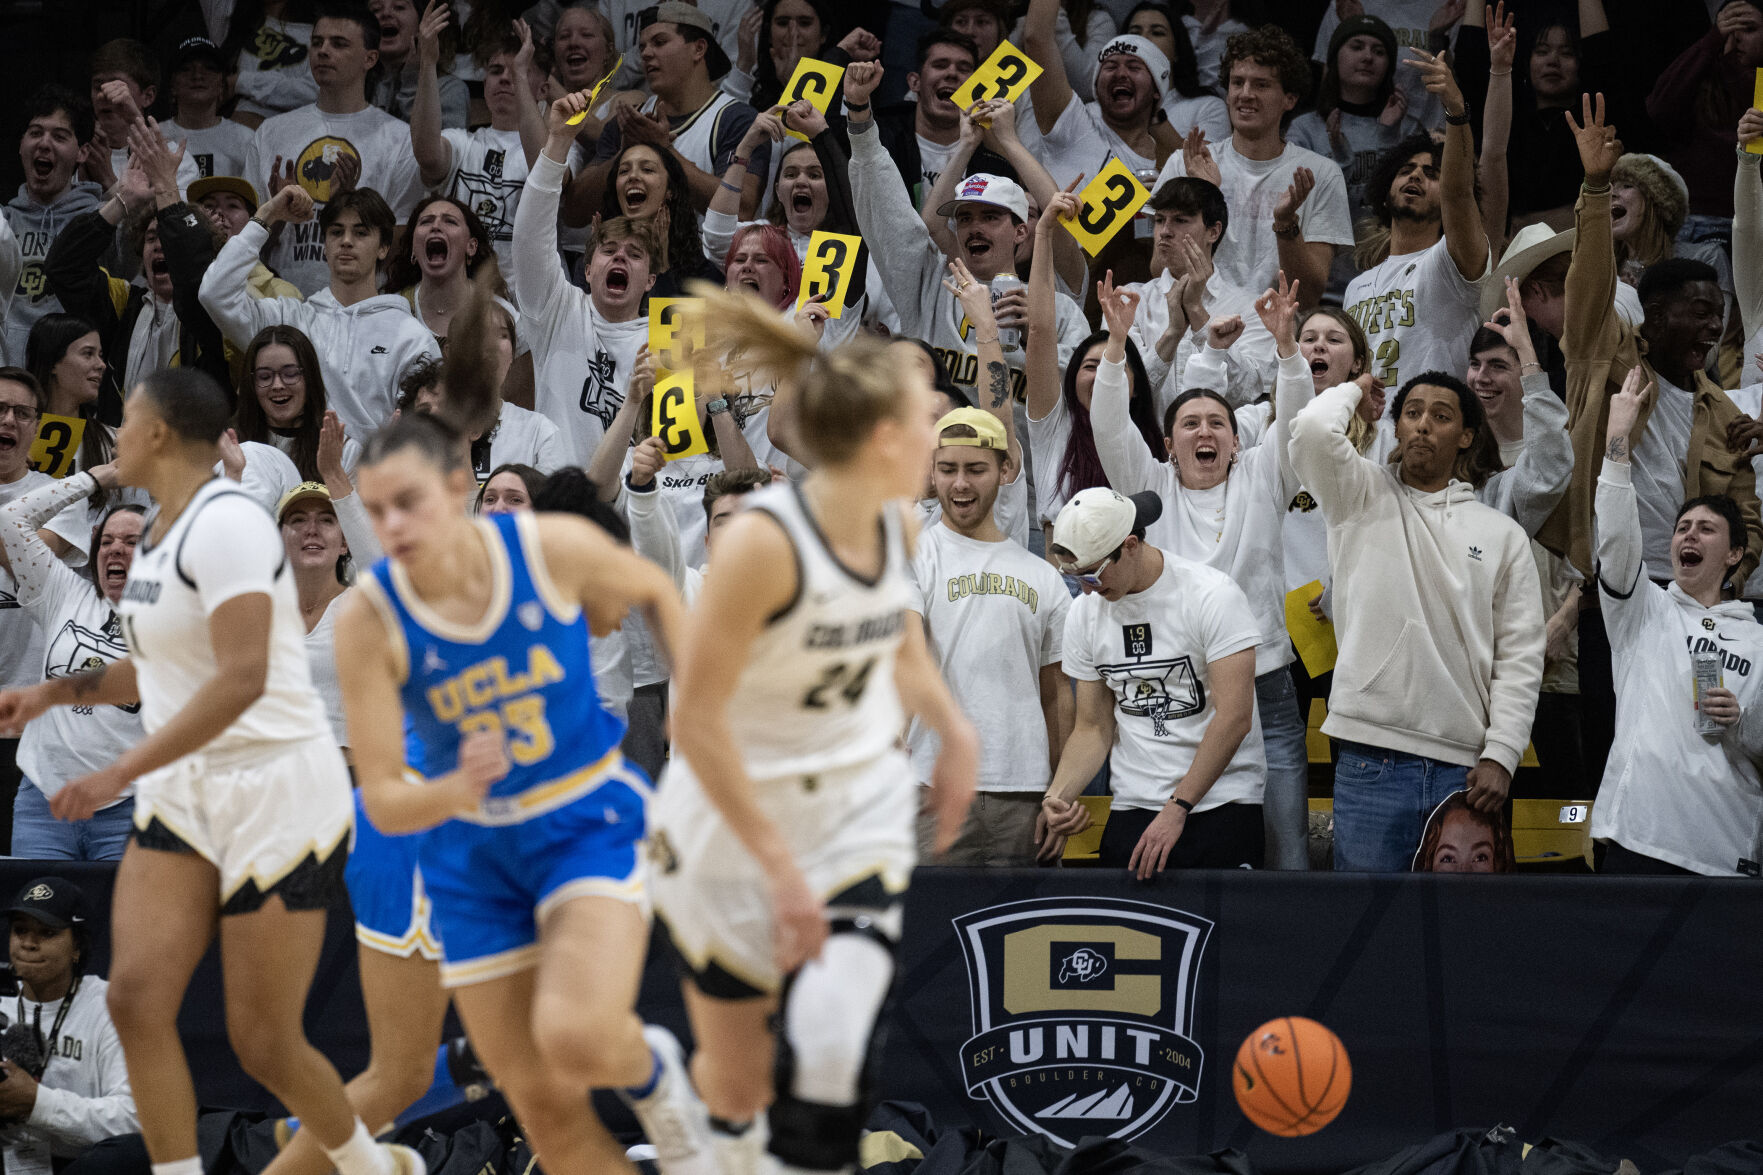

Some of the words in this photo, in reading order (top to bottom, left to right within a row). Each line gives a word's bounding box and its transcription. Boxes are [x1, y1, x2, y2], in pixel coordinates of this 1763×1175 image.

[1098, 41, 1138, 62] Cookies
[971, 54, 1028, 102] 3
[1078, 174, 1136, 235] 3
[809, 239, 848, 304] 3
[659, 386, 692, 454] 3
[30, 421, 72, 476] 3
[662, 476, 693, 490] SKO
[947, 572, 1039, 615] COLORADO
[1129, 626, 1145, 641] 1.9
[1132, 641, 1145, 655] 00
[429, 643, 566, 723] UCLA
[803, 656, 878, 710] 24
[1569, 807, 1578, 821] 9
[1003, 925, 1162, 1017] C
[1072, 952, 1094, 974] CU
[973, 1045, 996, 1067] EST
[1009, 1025, 1160, 1066] UNIT
[1165, 1047, 1191, 1070] 2004
[1010, 1069, 1115, 1088] BOULDER,
[1136, 1075, 1158, 1090] CO
